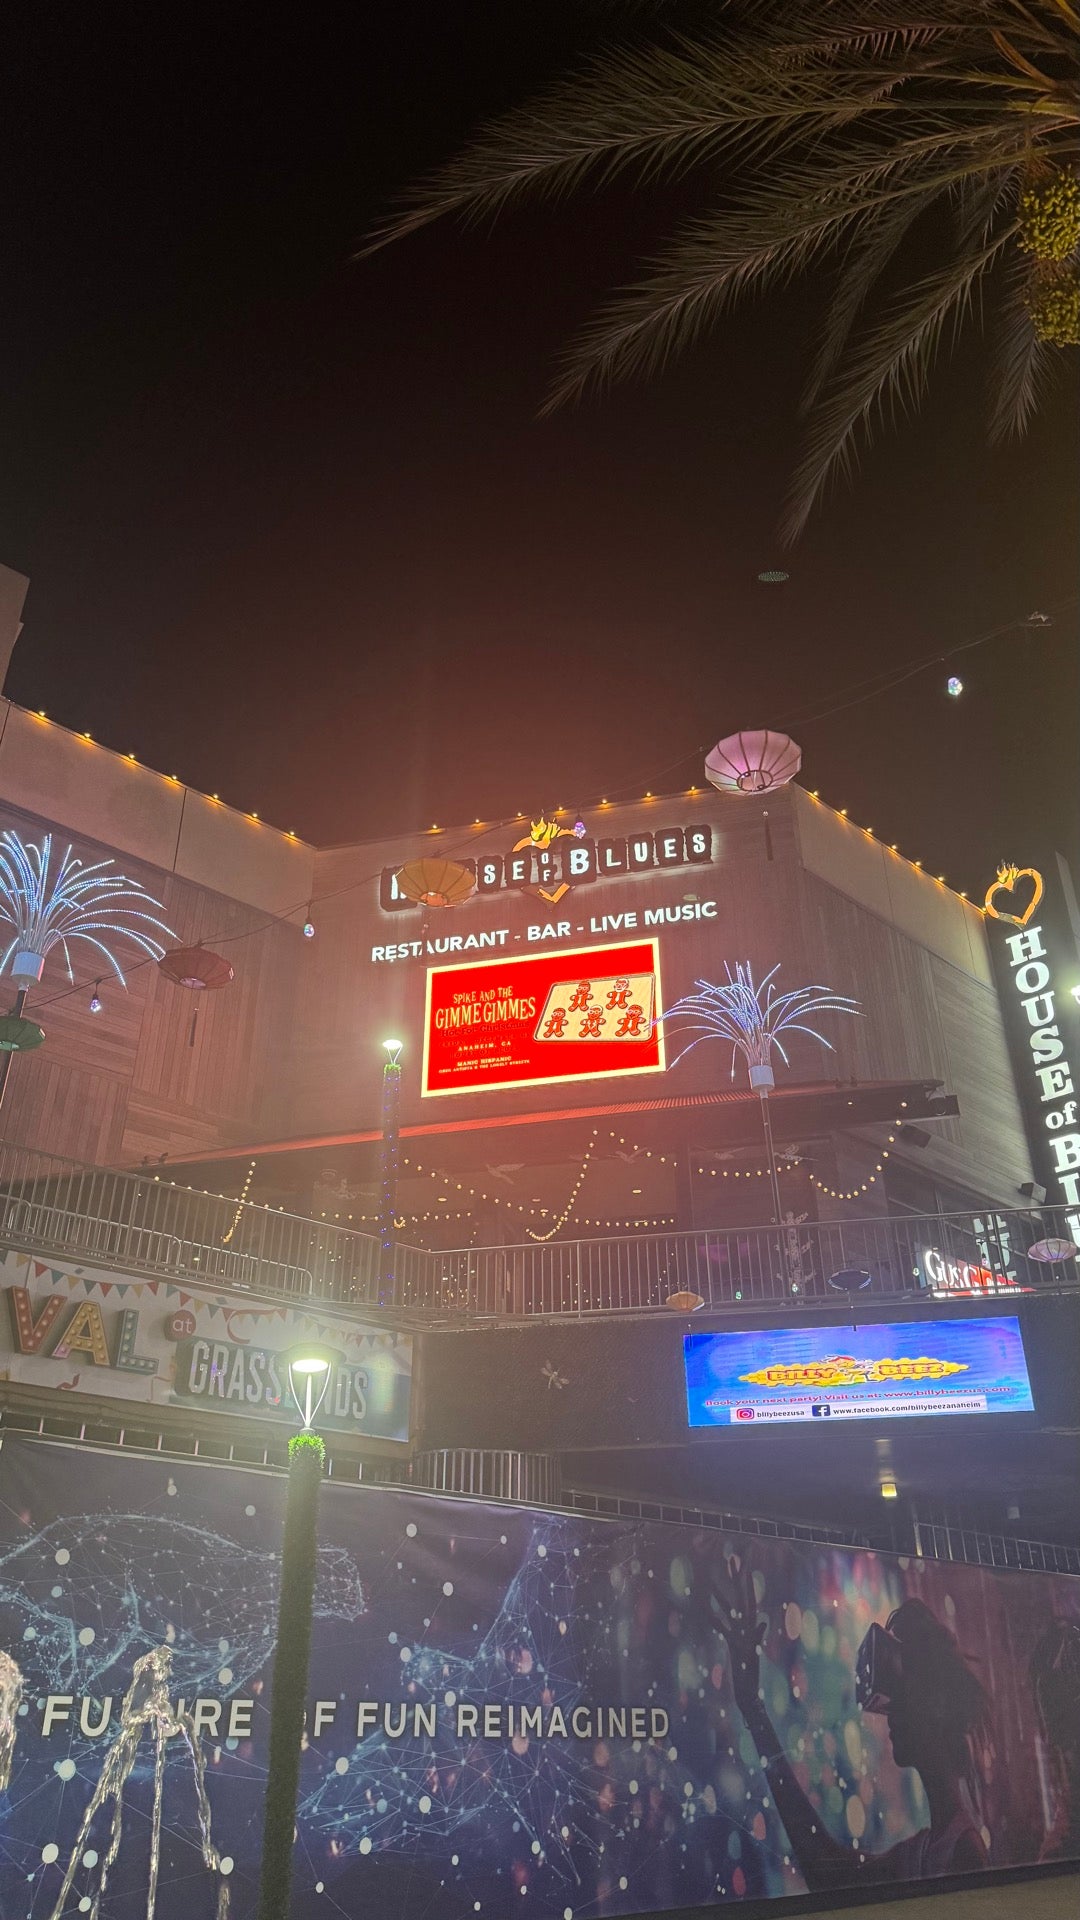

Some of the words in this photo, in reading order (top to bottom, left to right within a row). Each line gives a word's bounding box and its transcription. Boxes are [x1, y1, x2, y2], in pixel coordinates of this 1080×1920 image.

[570, 834, 706, 875] BLUES
[372, 930, 509, 962] RESTAURANT
[528, 922, 571, 941] BAR
[591, 912, 638, 933] LIVE
[644, 902, 718, 926] MUSIC
[453, 991, 477, 1004] SPIKE
[479, 990, 496, 1002] AND
[498, 985, 513, 998] THE
[435, 1003, 482, 1029] GIMME
[483, 996, 536, 1023] GIMMES
[1005, 925, 1075, 1101] HOUSE
[1045, 1100, 1077, 1129] of
[172, 1319, 192, 1335] at
[767, 1367, 837, 1382] BILLY
[879, 1362, 944, 1376] BEEZ
[356, 1702, 437, 1738] FUN
[457, 1704, 669, 1738] REIMAGINED
